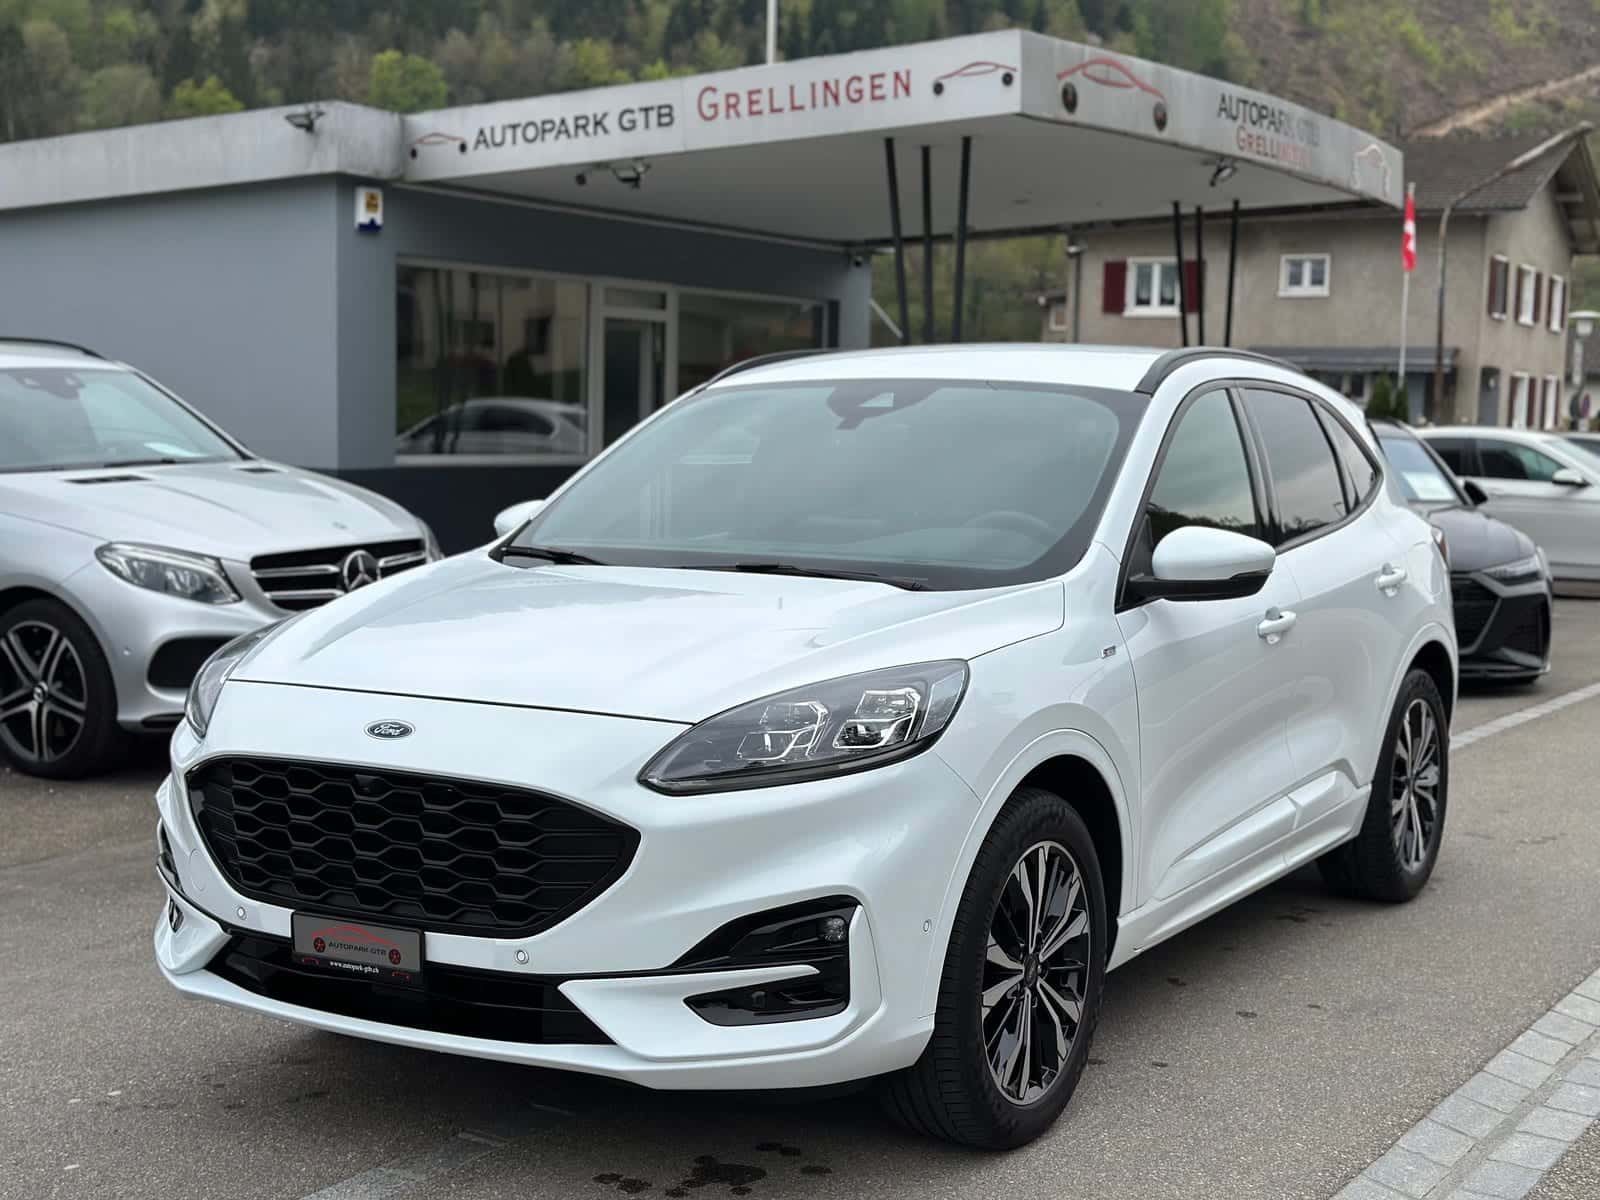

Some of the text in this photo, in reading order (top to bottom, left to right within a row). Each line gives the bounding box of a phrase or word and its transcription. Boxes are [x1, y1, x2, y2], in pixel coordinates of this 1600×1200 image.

[473, 69, 912, 151] AUTOPARK GTB GRELLINGEN
[373, 722, 405, 736] Ford
[328, 941, 369, 953] AUTOPARK
